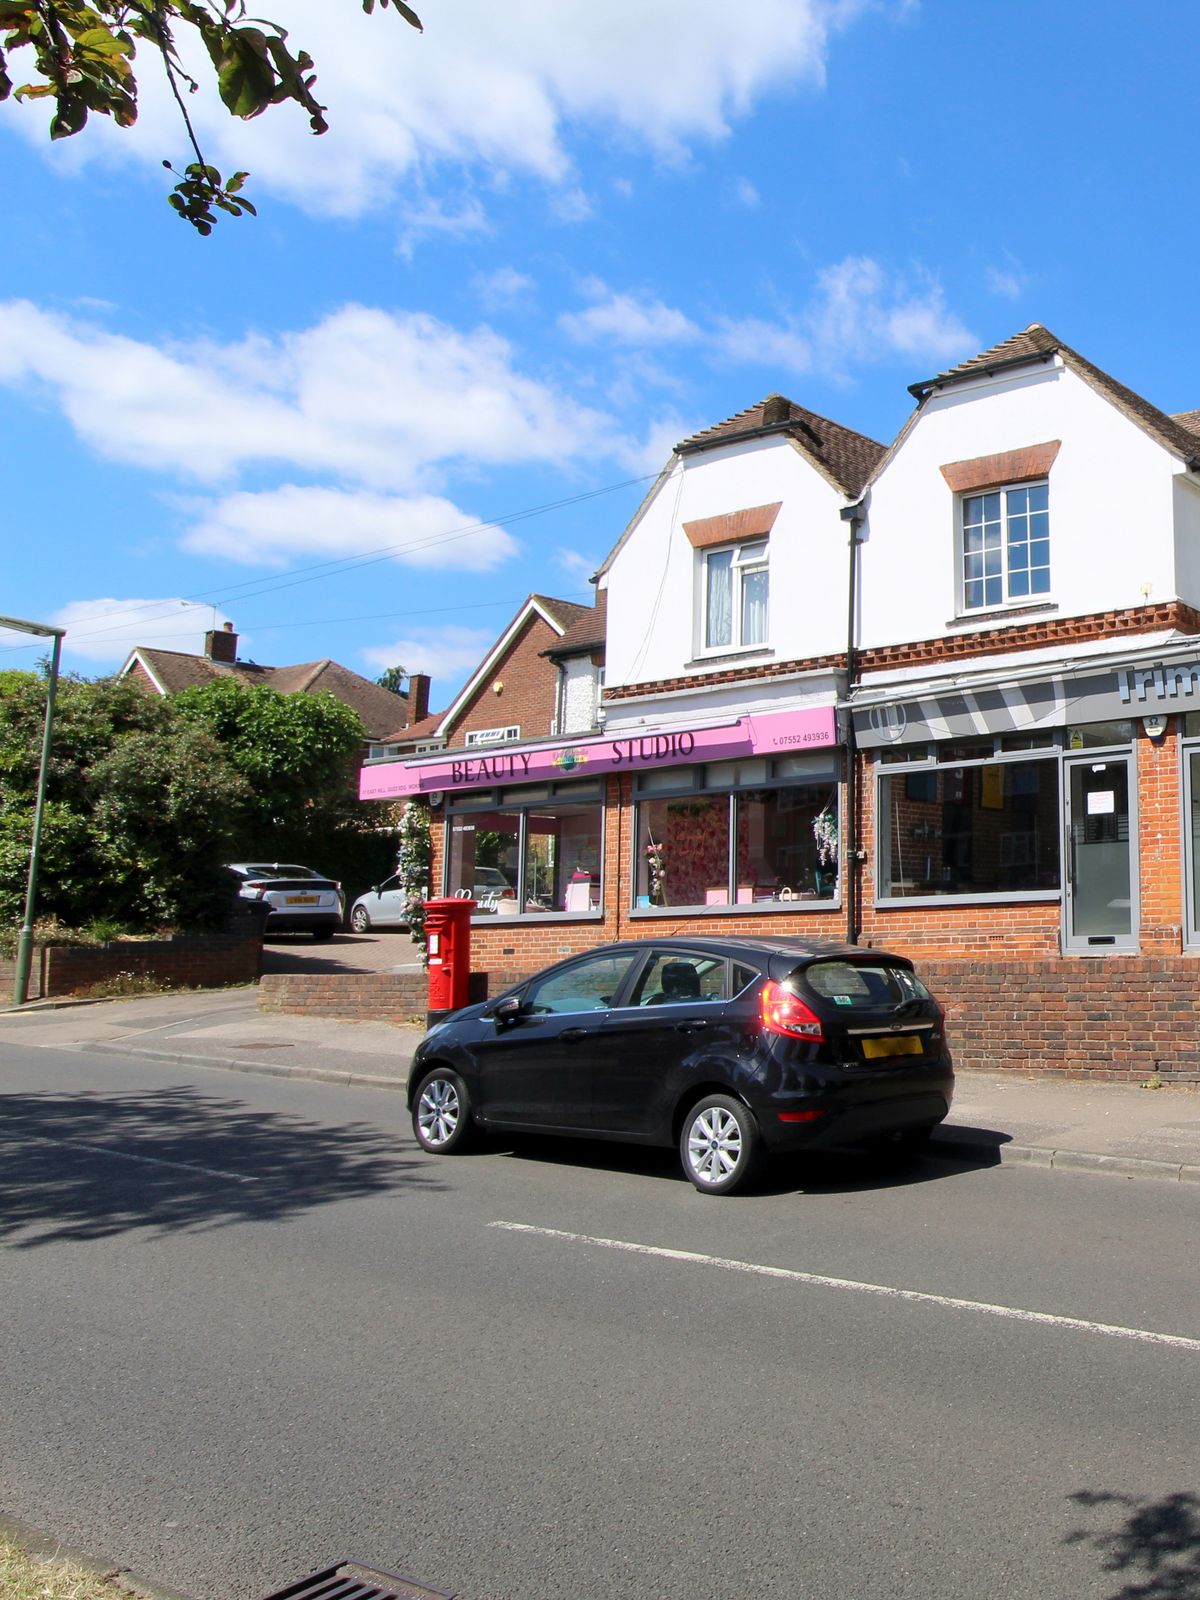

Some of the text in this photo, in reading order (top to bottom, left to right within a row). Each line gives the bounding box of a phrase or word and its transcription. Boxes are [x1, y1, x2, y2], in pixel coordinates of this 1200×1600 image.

[779, 731, 830, 746] 07552 493936
[452, 752, 532, 784] BEAUTY
[611, 732, 695, 765] STUDIO
[454, 888, 505, 913] Buty
